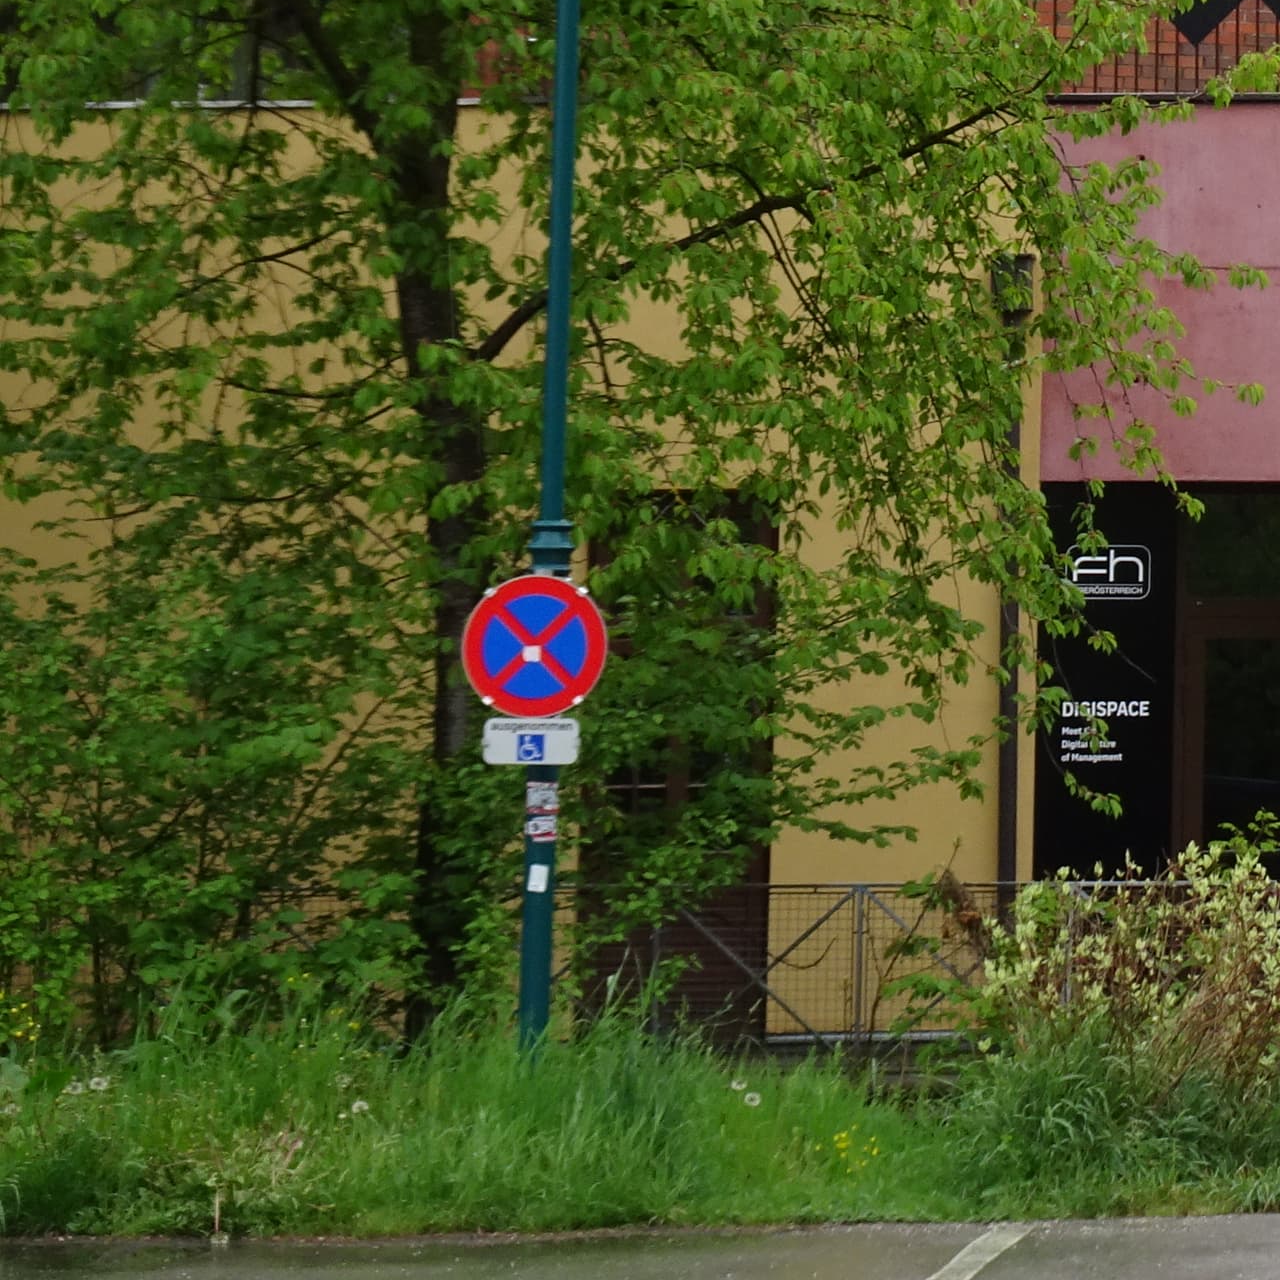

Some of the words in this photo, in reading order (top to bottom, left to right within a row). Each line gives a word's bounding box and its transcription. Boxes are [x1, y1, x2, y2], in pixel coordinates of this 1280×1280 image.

[1062, 701, 1150, 717] DIGISPACE
[491, 722, 573, 733] ausgenommen
[1061, 753, 1070, 762] of
[1071, 753, 1123, 763] Management
